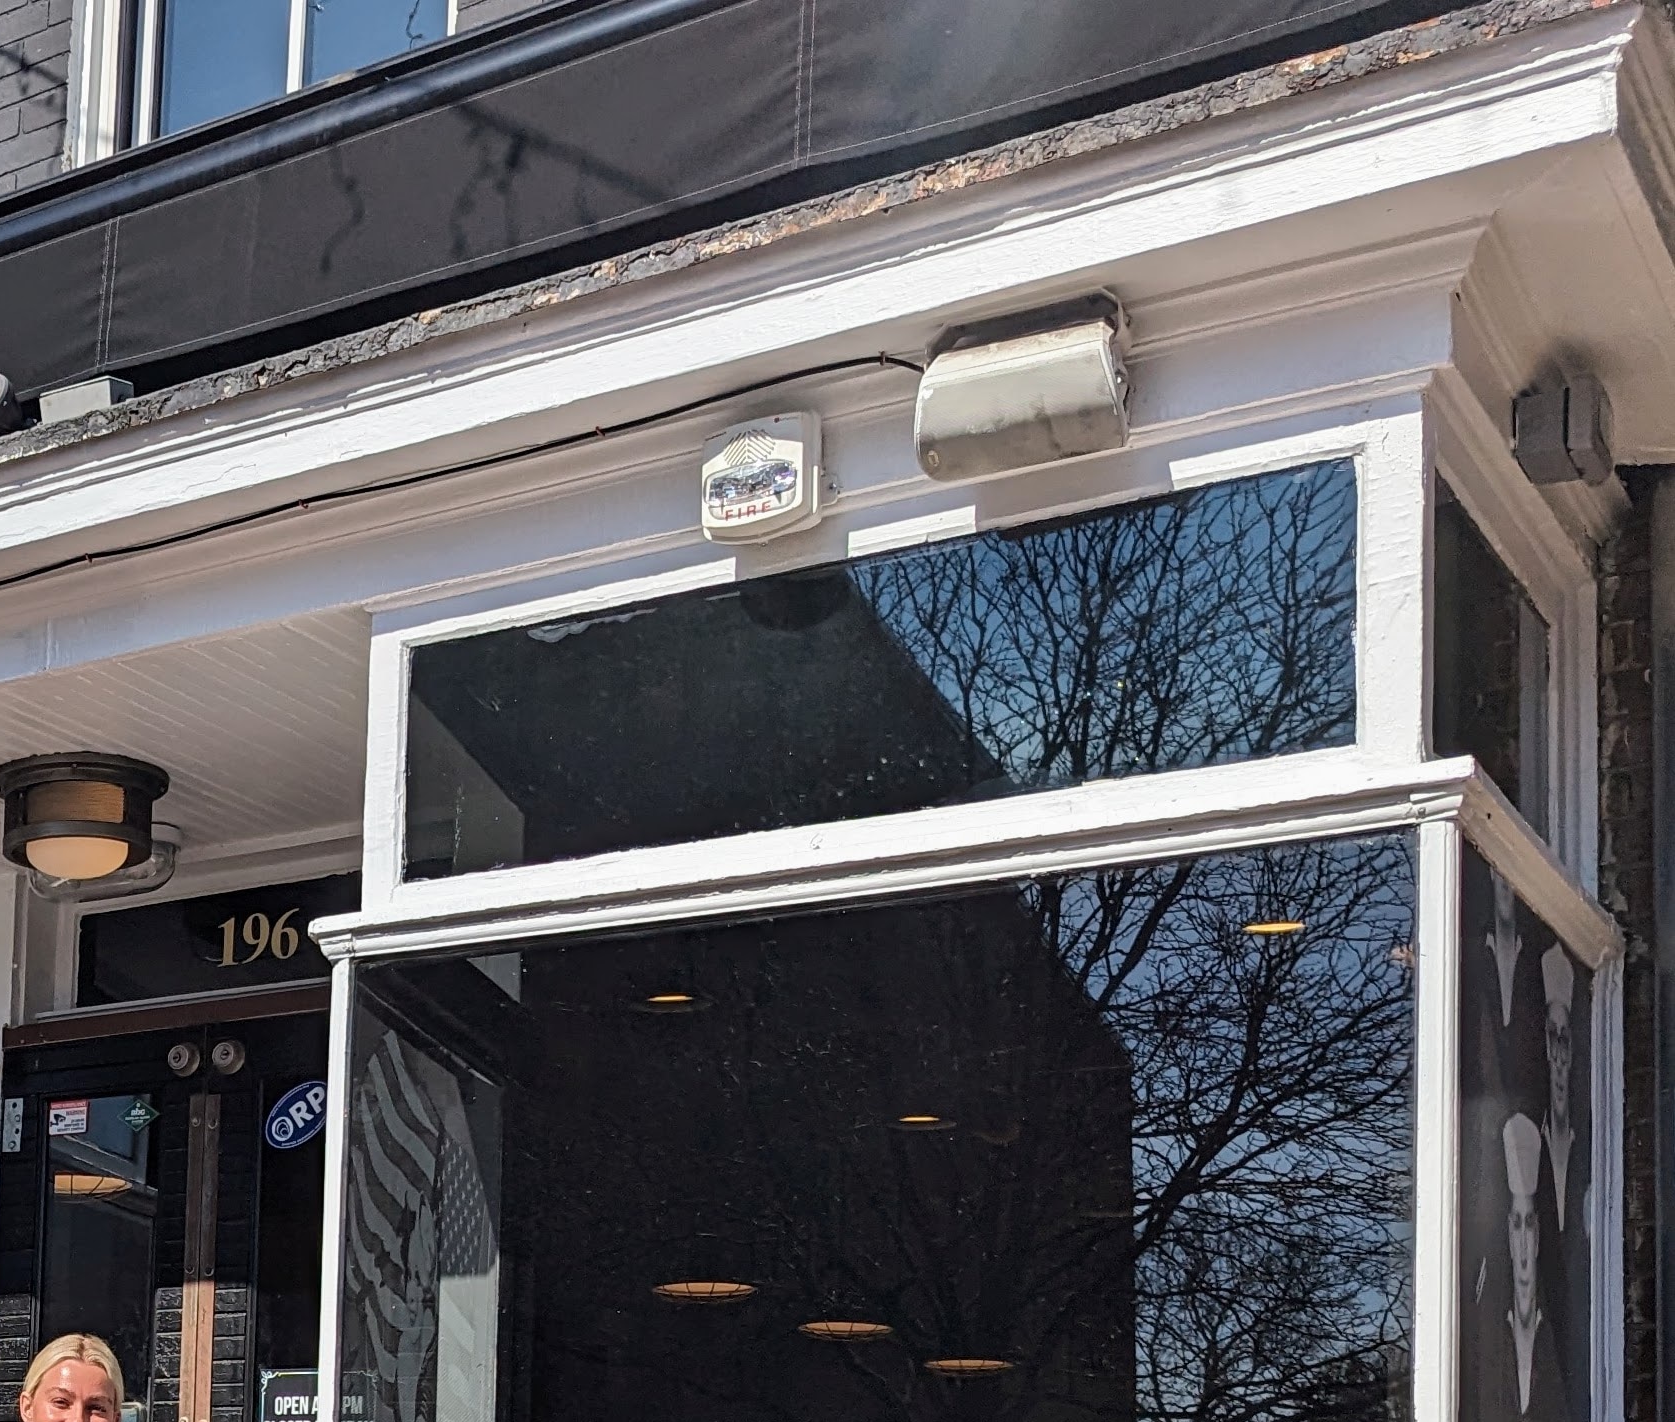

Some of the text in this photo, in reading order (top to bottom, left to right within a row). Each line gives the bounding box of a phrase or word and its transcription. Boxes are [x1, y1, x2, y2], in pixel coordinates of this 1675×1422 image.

[724, 501, 772, 521] FIRE
[216, 908, 300, 968] 196
[274, 1396, 309, 1415] OPEN
